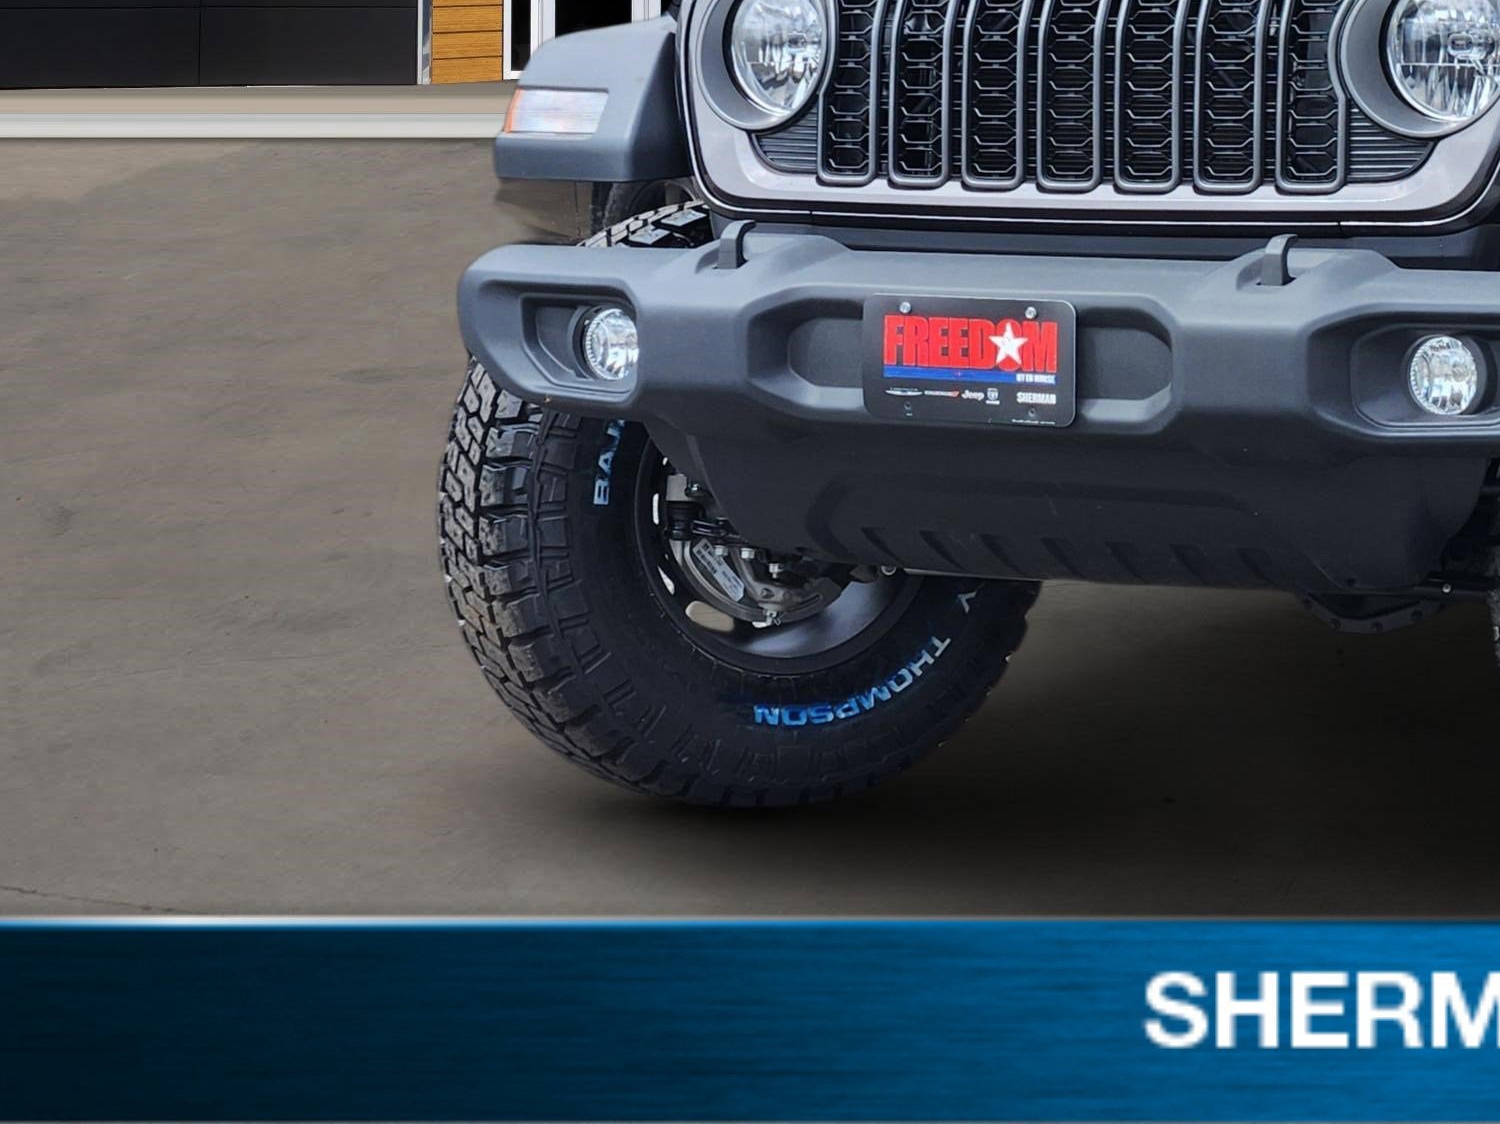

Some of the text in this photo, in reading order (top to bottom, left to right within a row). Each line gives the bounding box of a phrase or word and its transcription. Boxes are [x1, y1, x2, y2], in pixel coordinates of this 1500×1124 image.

[883, 314, 1058, 373] FREEDOM
[961, 389, 985, 401] Jeep
[1016, 391, 1057, 405] SHERMAN
[593, 419, 627, 506] BAJ
[753, 635, 952, 726] THOMPSON
